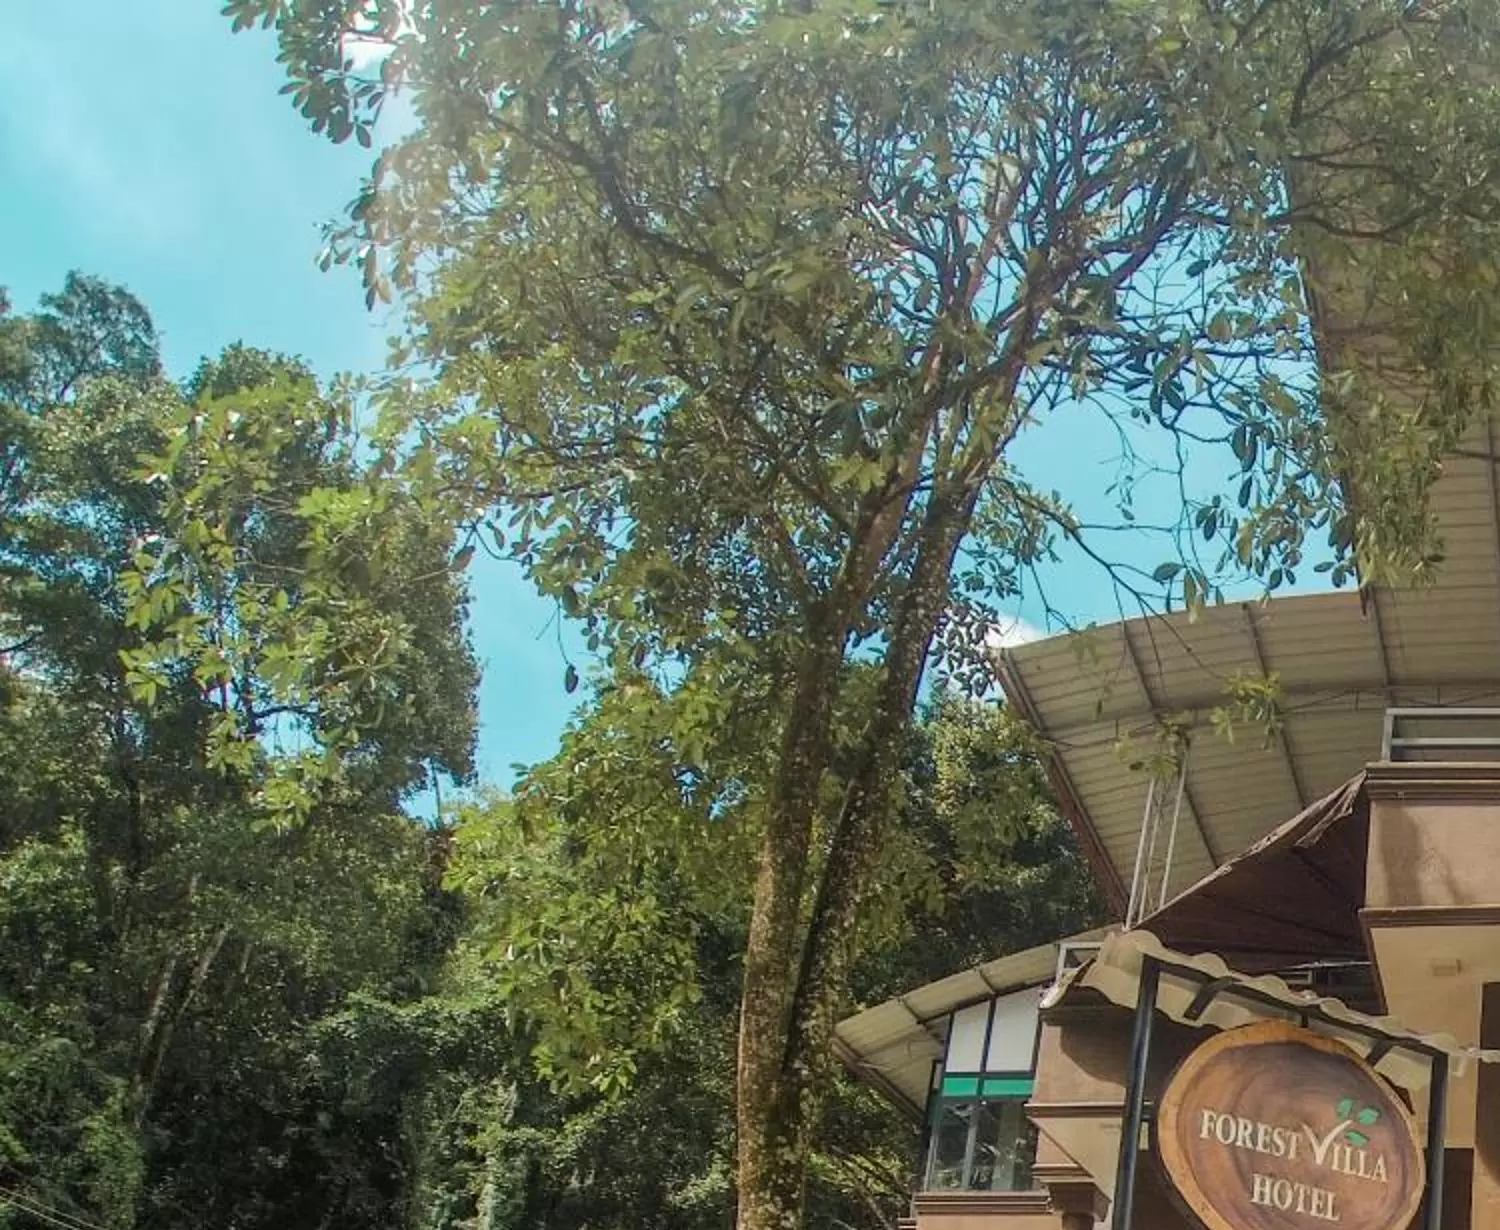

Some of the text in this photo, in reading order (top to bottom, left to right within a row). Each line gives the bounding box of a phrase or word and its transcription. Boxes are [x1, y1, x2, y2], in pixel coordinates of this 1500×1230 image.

[1200, 1108, 1388, 1182] FOREST VILLA
[1251, 1172, 1341, 1221] HOTEL
